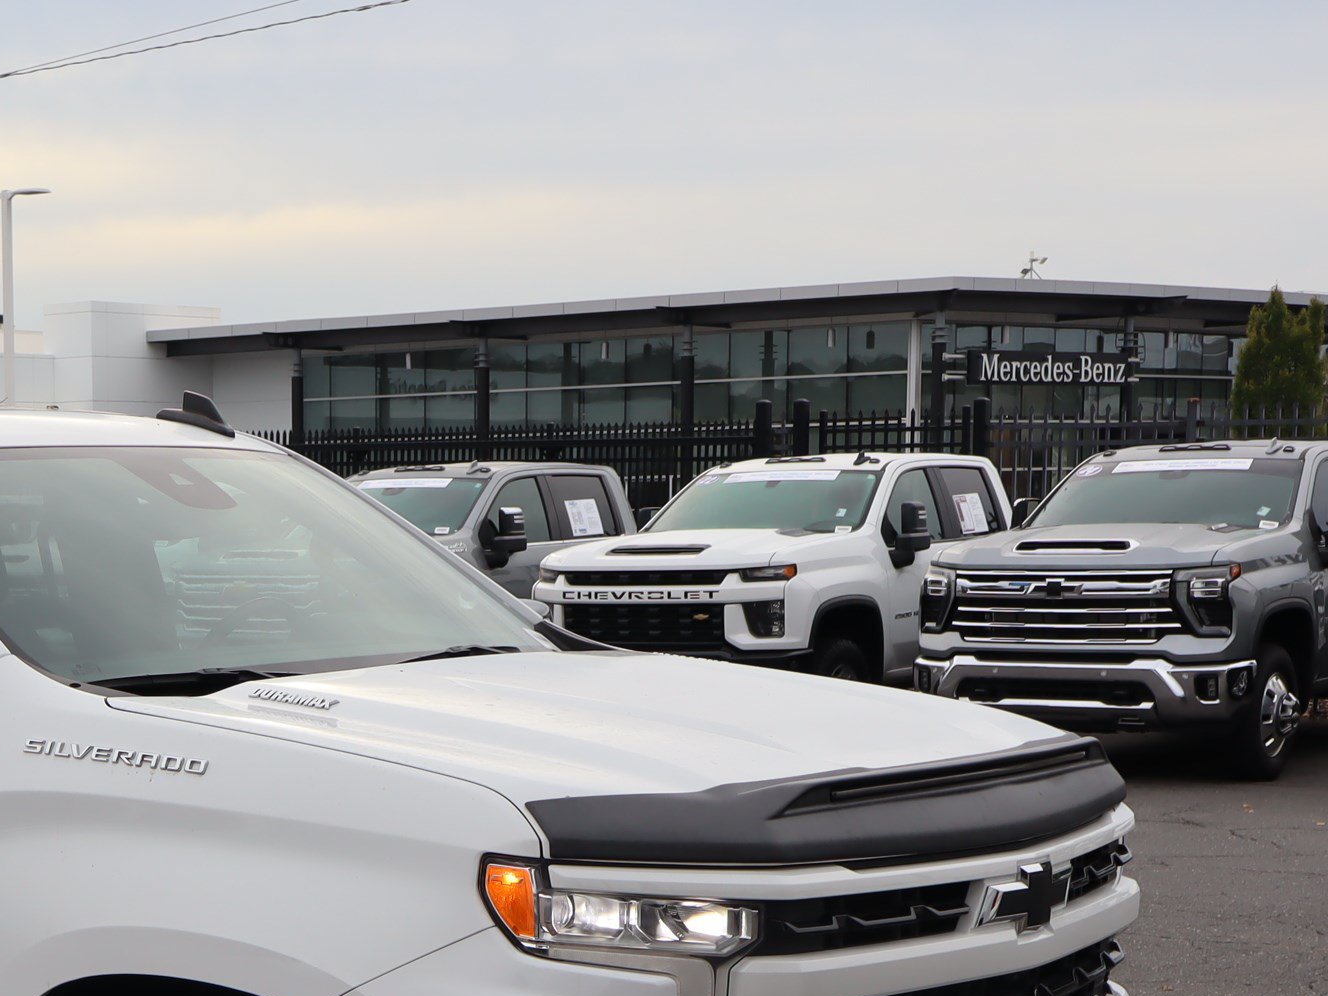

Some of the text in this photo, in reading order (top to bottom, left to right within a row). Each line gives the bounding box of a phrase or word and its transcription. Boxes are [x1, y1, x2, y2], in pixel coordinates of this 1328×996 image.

[979, 353, 1126, 383] Mercedes-Benz
[562, 590, 720, 600] CHEVROLET
[248, 687, 341, 711] DURAMAX
[22, 737, 210, 776] SILVERADO
